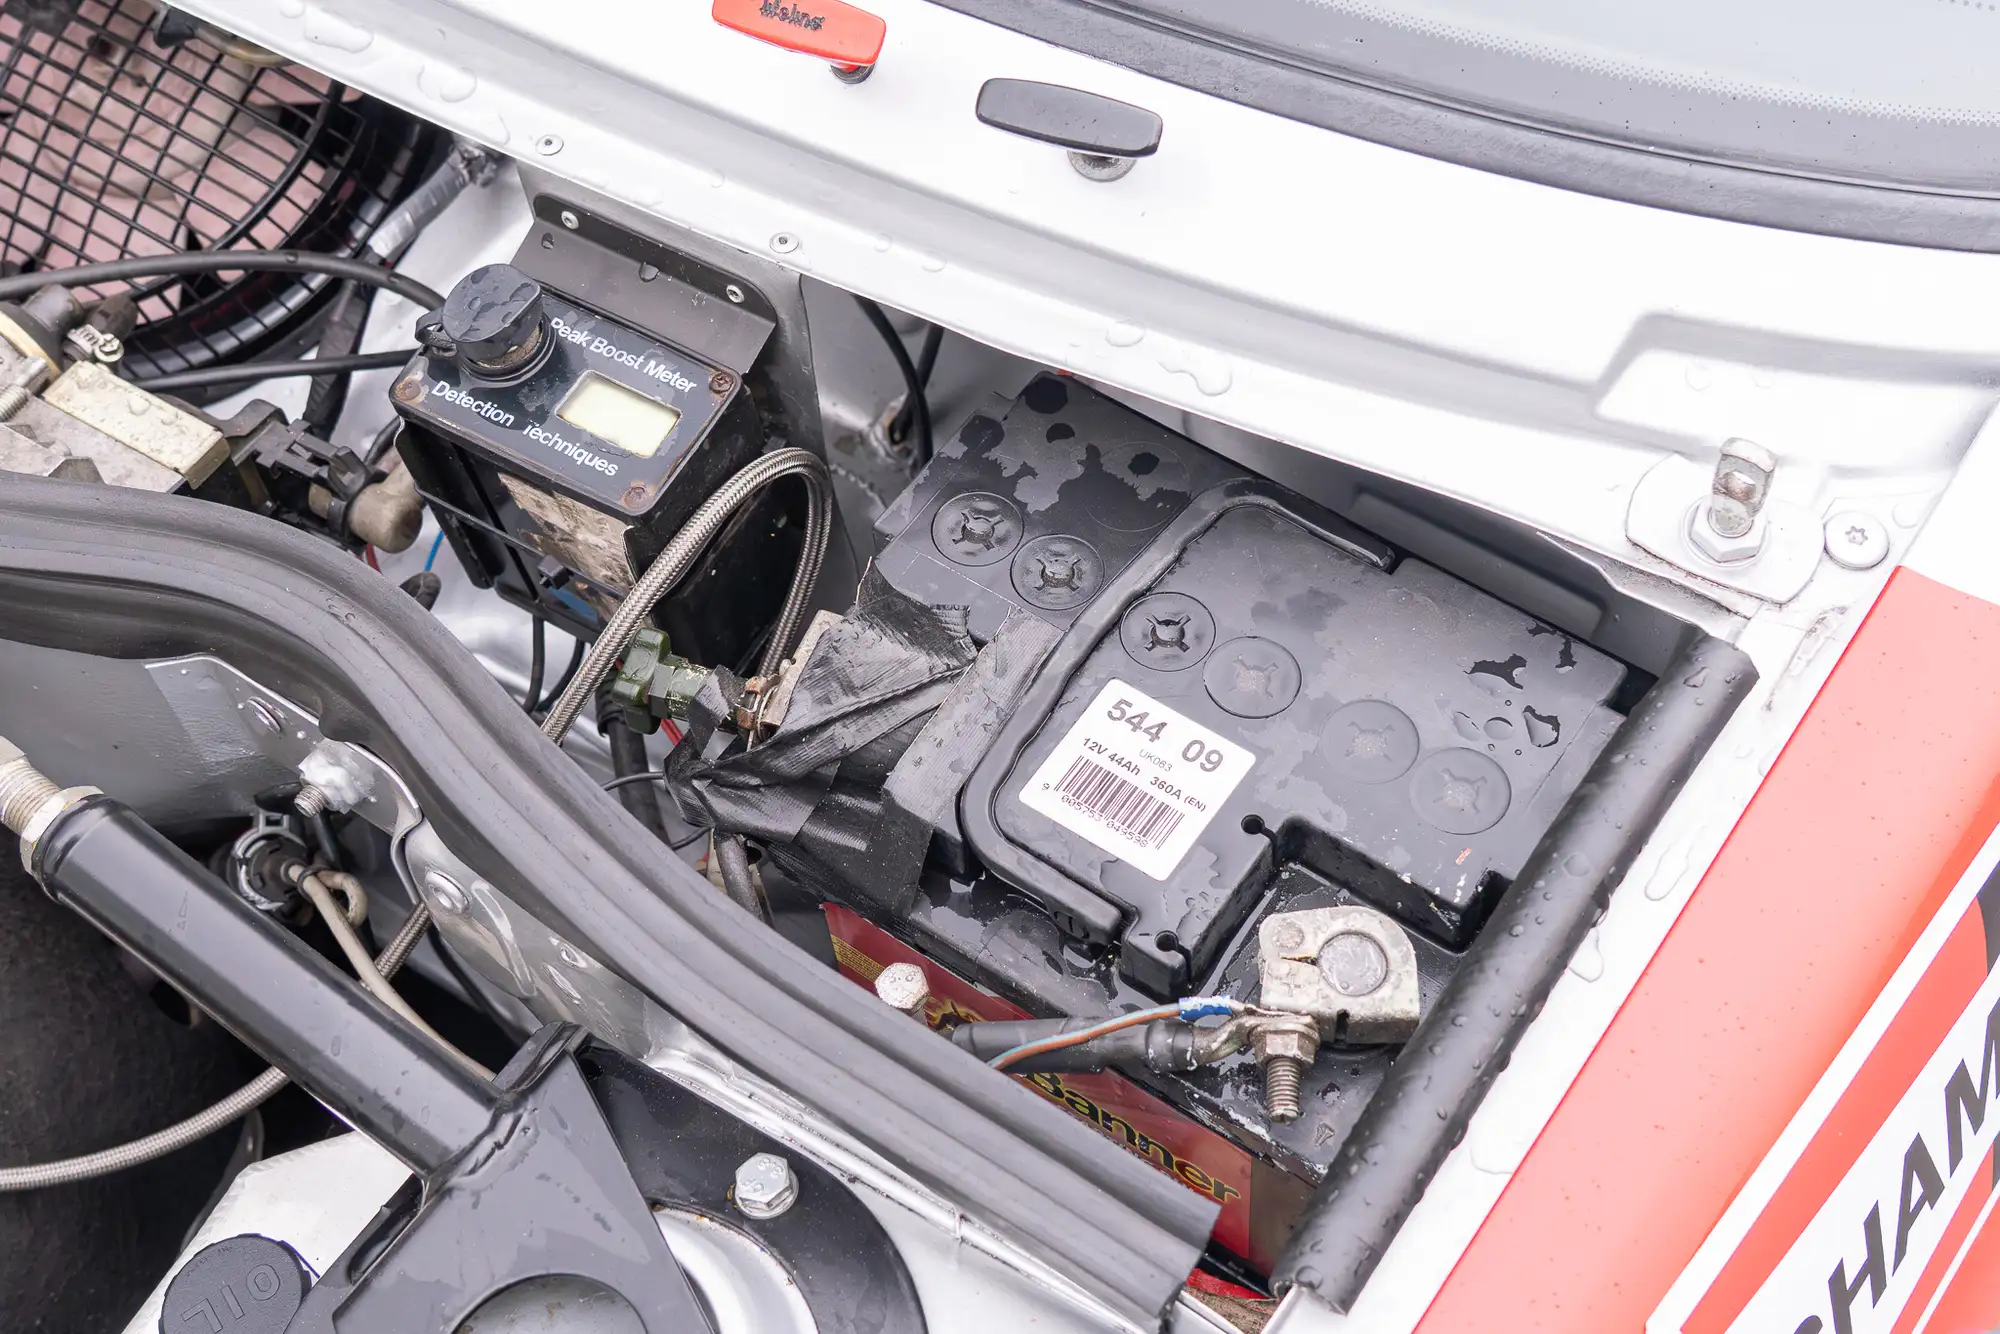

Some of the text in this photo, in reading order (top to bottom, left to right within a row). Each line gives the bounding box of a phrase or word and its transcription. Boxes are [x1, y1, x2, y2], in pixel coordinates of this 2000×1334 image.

[550, 316, 697, 394] Peak Boost Meter
[431, 380, 515, 427] Detection
[1106, 698, 1224, 773] 544 09
[1138, 748, 1173, 772] UK063
[1082, 737, 1207, 812] 12V 44Ah 360A (EN)
[1023, 1072, 1241, 1202] Banner
[1793, 996, 2000, 1334] HAM
